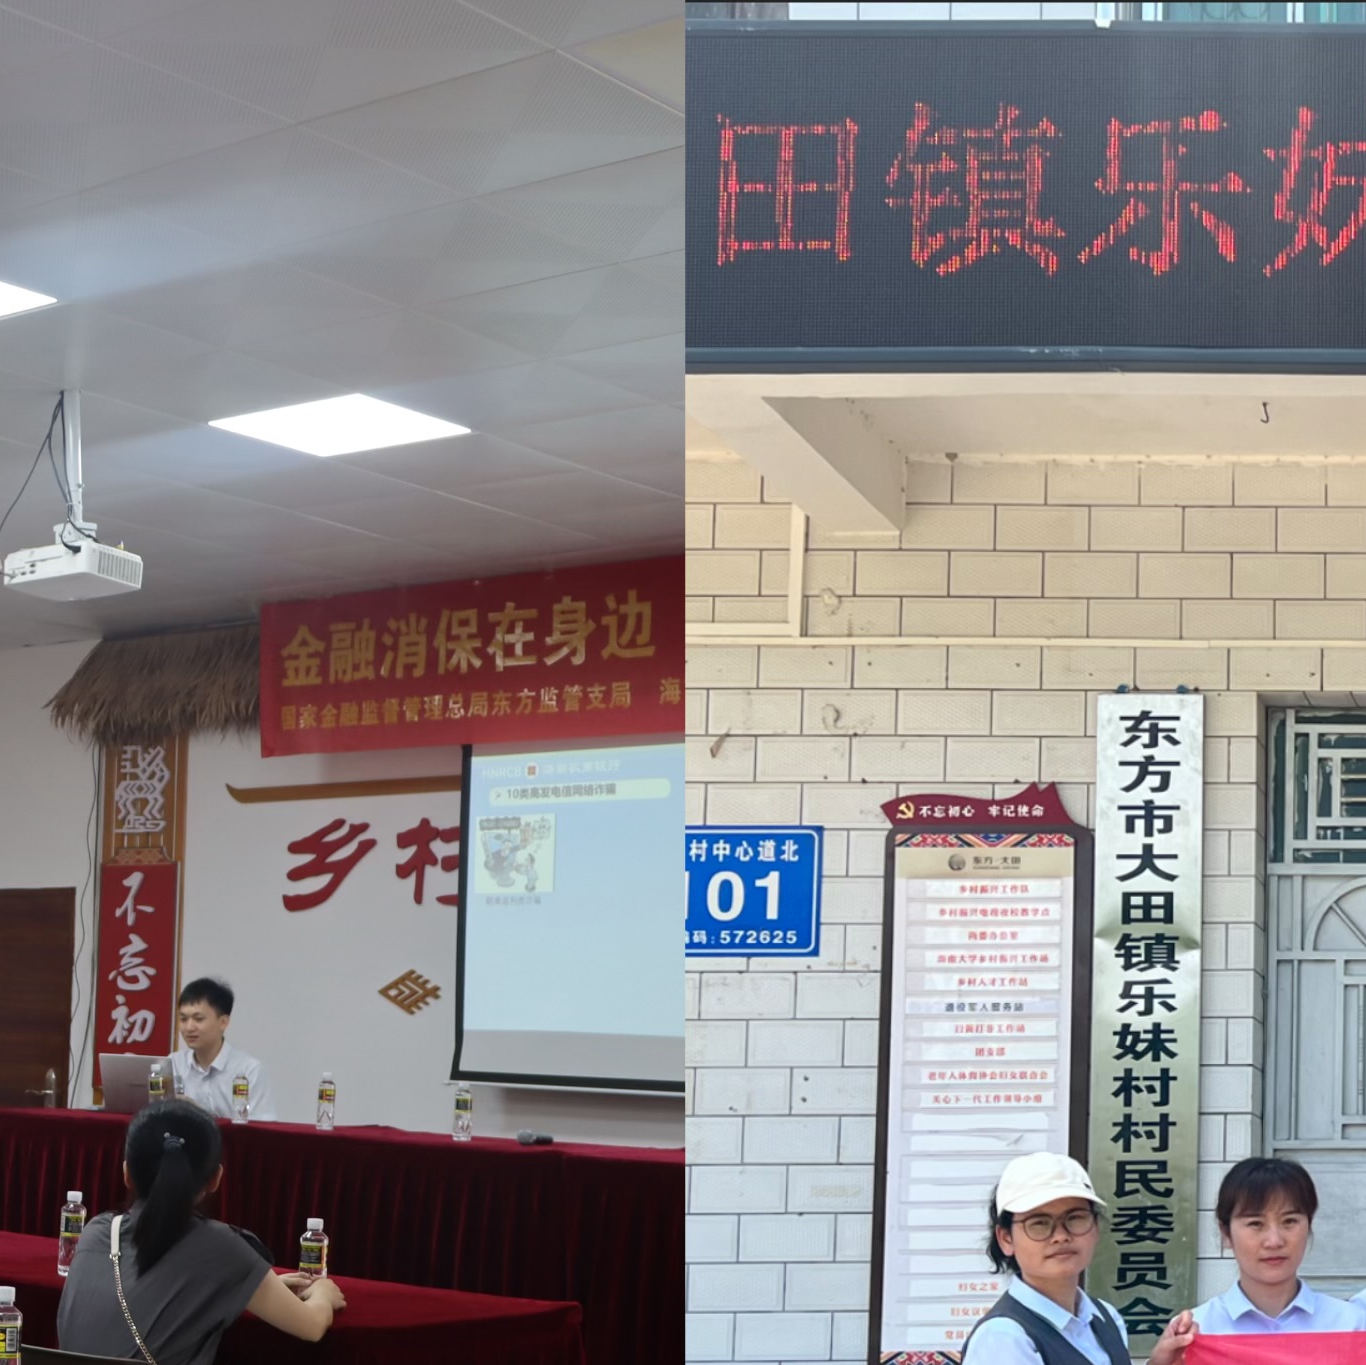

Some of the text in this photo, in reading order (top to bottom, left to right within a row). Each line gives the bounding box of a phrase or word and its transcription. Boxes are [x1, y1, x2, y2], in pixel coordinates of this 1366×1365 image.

[281, 590, 657, 688] 金融消保在身边
[281, 681, 632, 731] 国家金融监督管理总局东方监管支局
[507, 783, 617, 800] 10类高发电信网络诈骗
[918, 804, 1045, 819] 不忘初心 牢记使命
[689, 839, 800, 863] 村中心道北
[959, 885, 1030, 894] 乡村振兴工作队
[957, 977, 1029, 987] 乡村人才工作站
[945, 1002, 1025, 1013] 退役军人服务站
[1111, 709, 1182, 1339] 东方市大田镇乐妹村村民委员会
[958, 1281, 1000, 1292] 妇女之家
[944, 1330, 969, 1340] 党员
